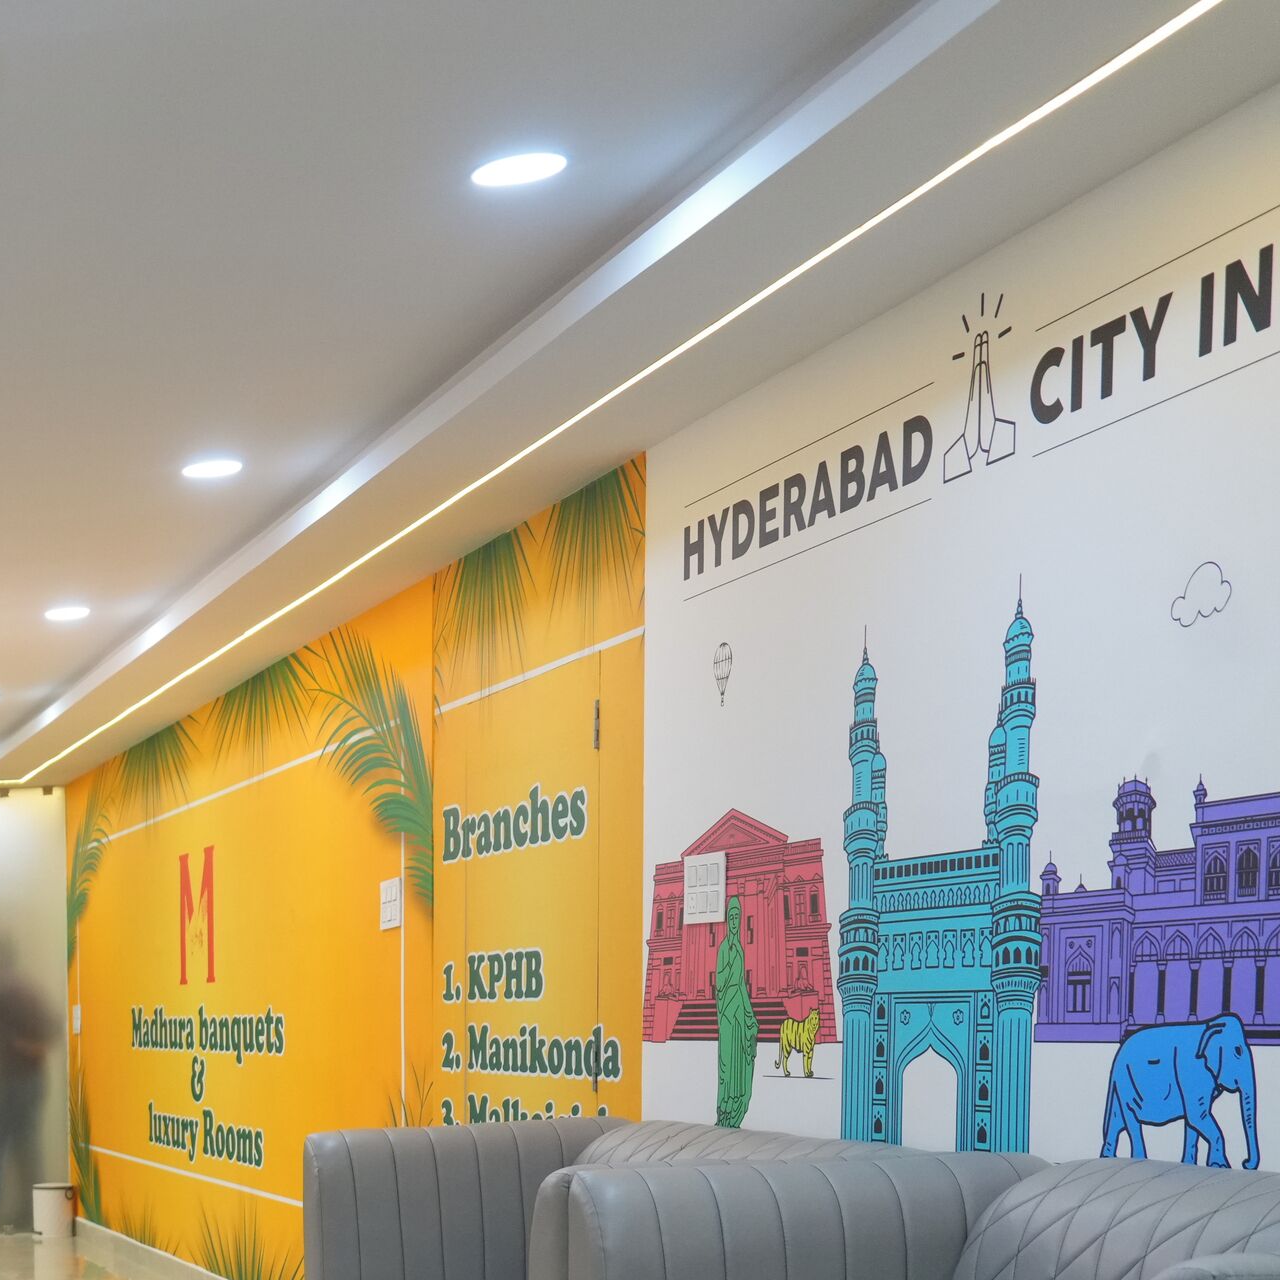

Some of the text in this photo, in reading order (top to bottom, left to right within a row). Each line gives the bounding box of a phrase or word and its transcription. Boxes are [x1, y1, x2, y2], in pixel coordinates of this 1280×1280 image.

[683, 243, 1274, 582] HYDERABAD CITY IN
[442, 784, 586, 863] Branches
[442, 949, 544, 1003] 1. KPHB
[131, 1003, 285, 1066] Madhura banquets
[441, 1023, 622, 1080] 2. Manikonda
[191, 1055, 205, 1102] &
[148, 1101, 264, 1169] luxury Rooms
[441, 1098, 461, 1126] 3
